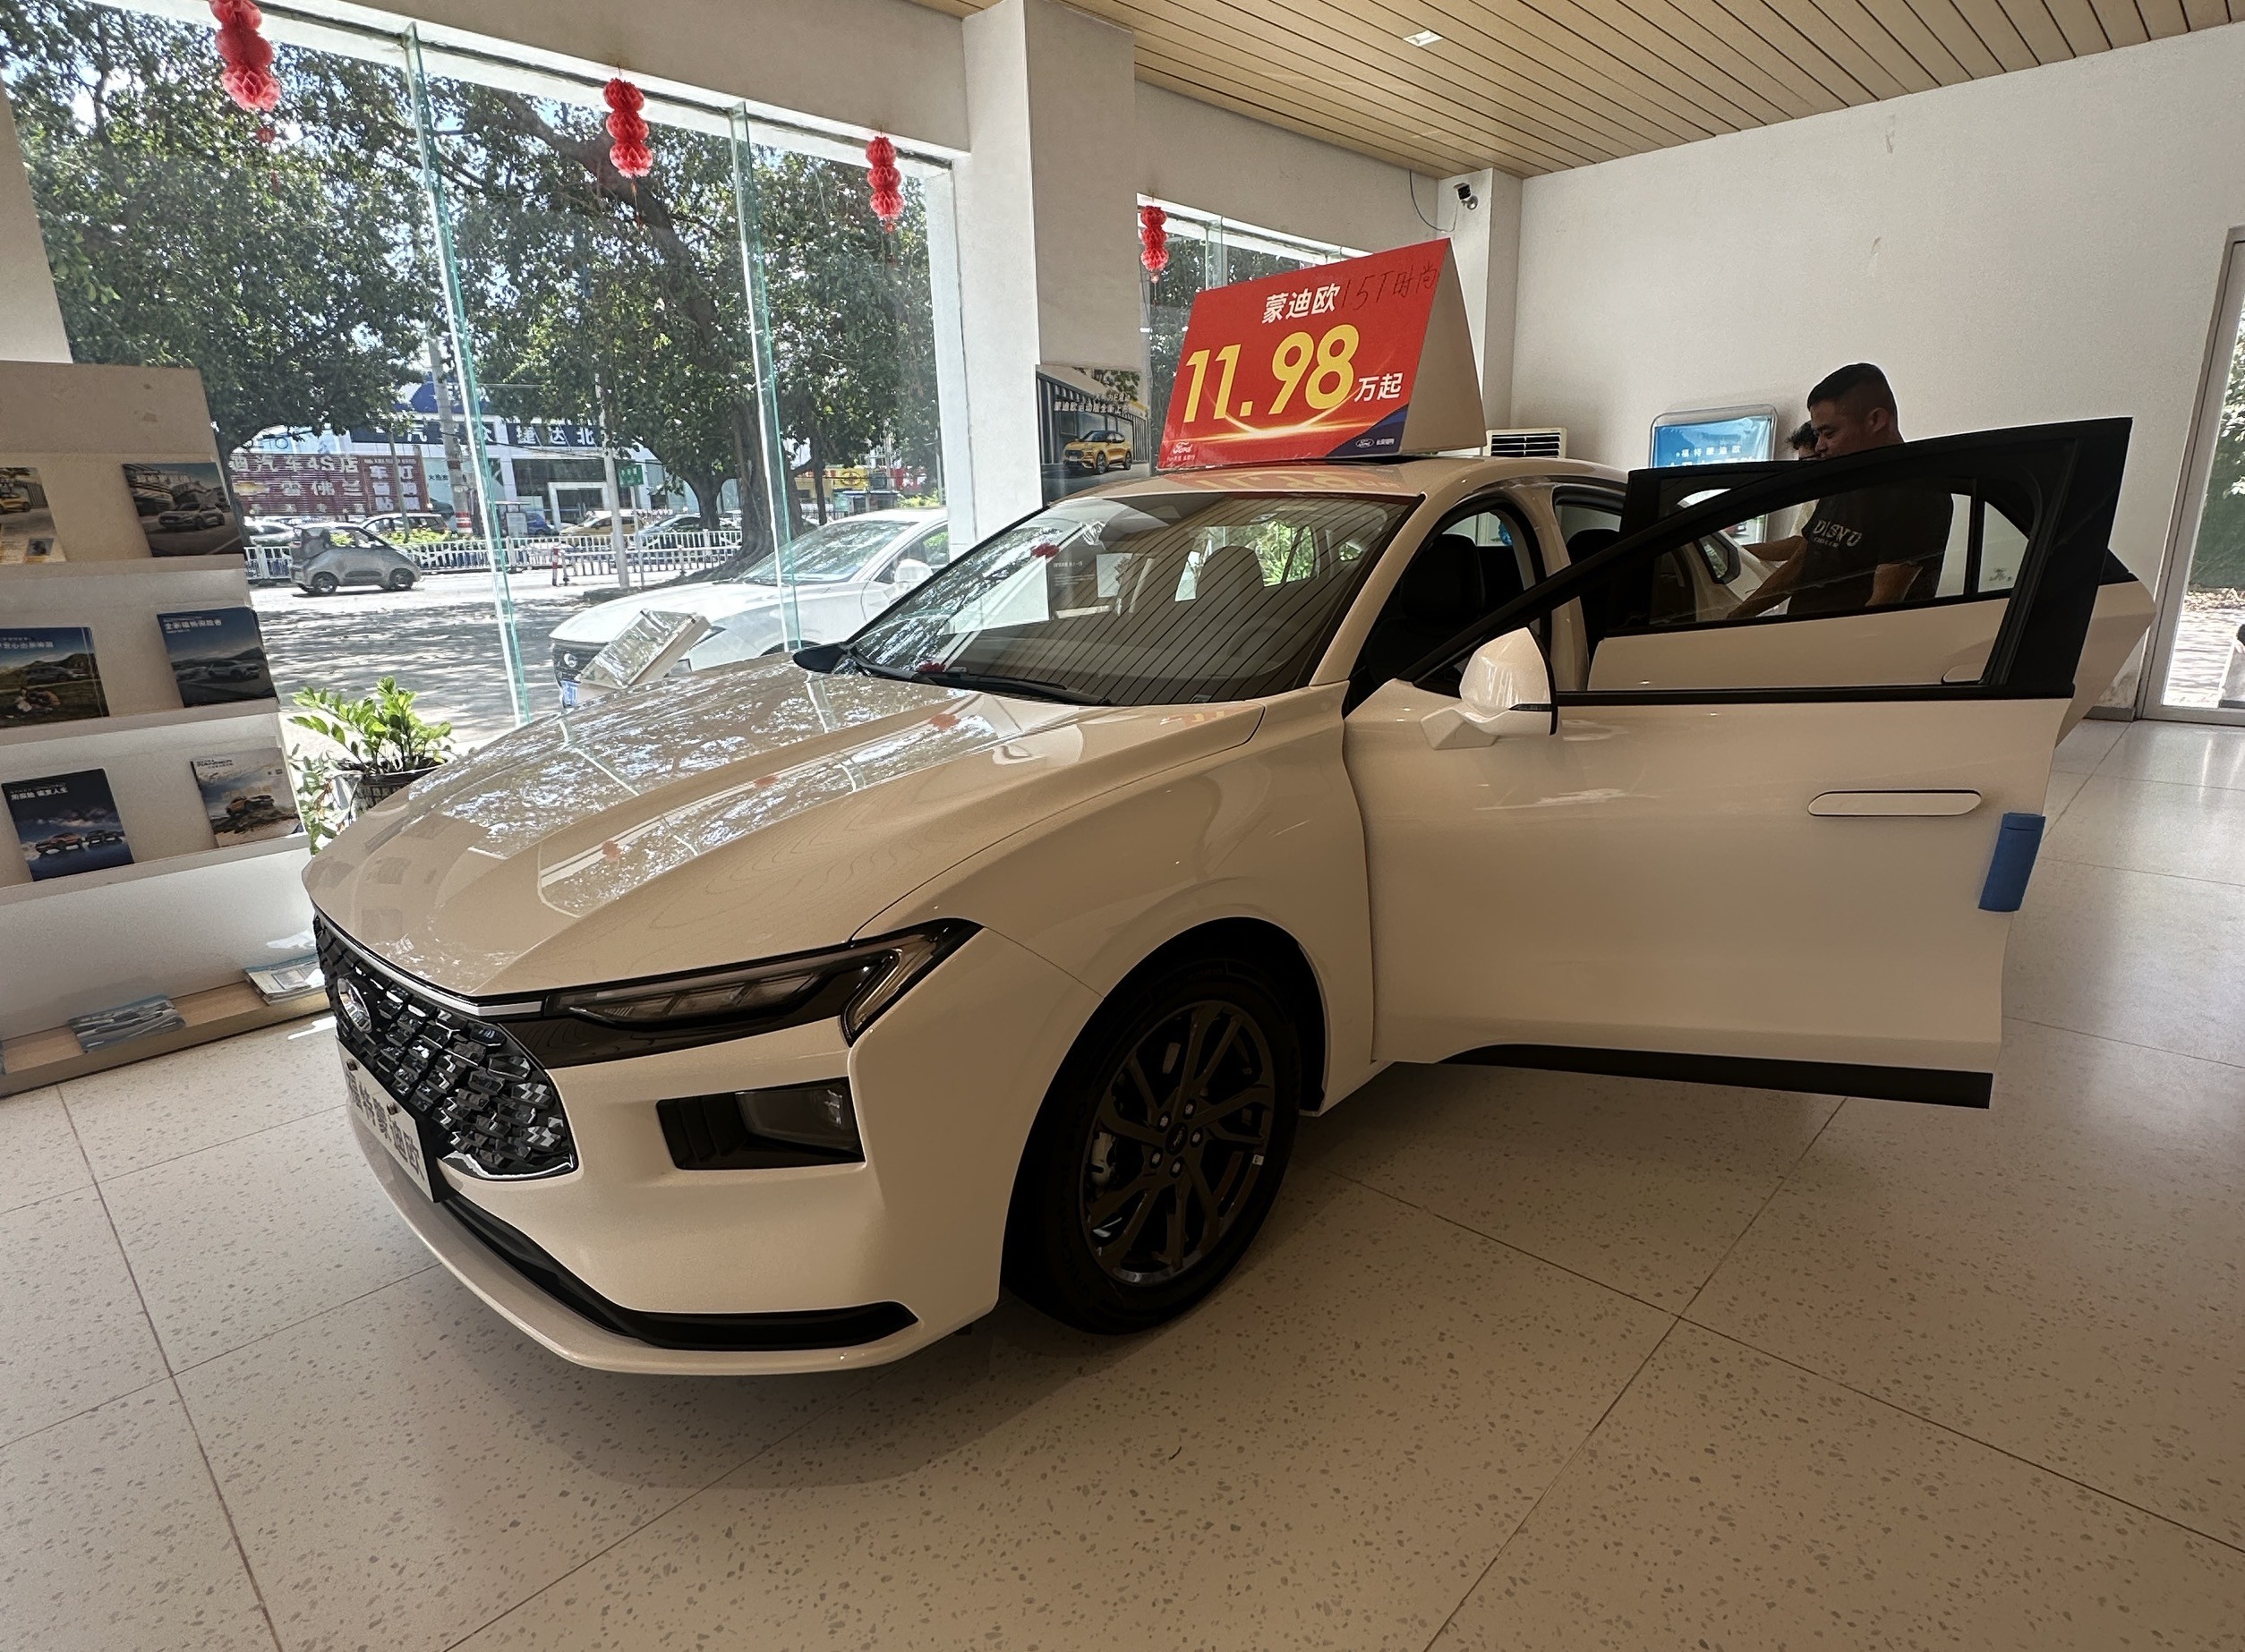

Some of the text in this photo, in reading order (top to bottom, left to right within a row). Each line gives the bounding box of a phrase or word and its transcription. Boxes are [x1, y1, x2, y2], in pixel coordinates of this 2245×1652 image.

[1262, 282, 1341, 324] 蒙迪欧
[1182, 324, 1403, 424] 11.98 万起
[1173, 441, 1193, 454] Ford
